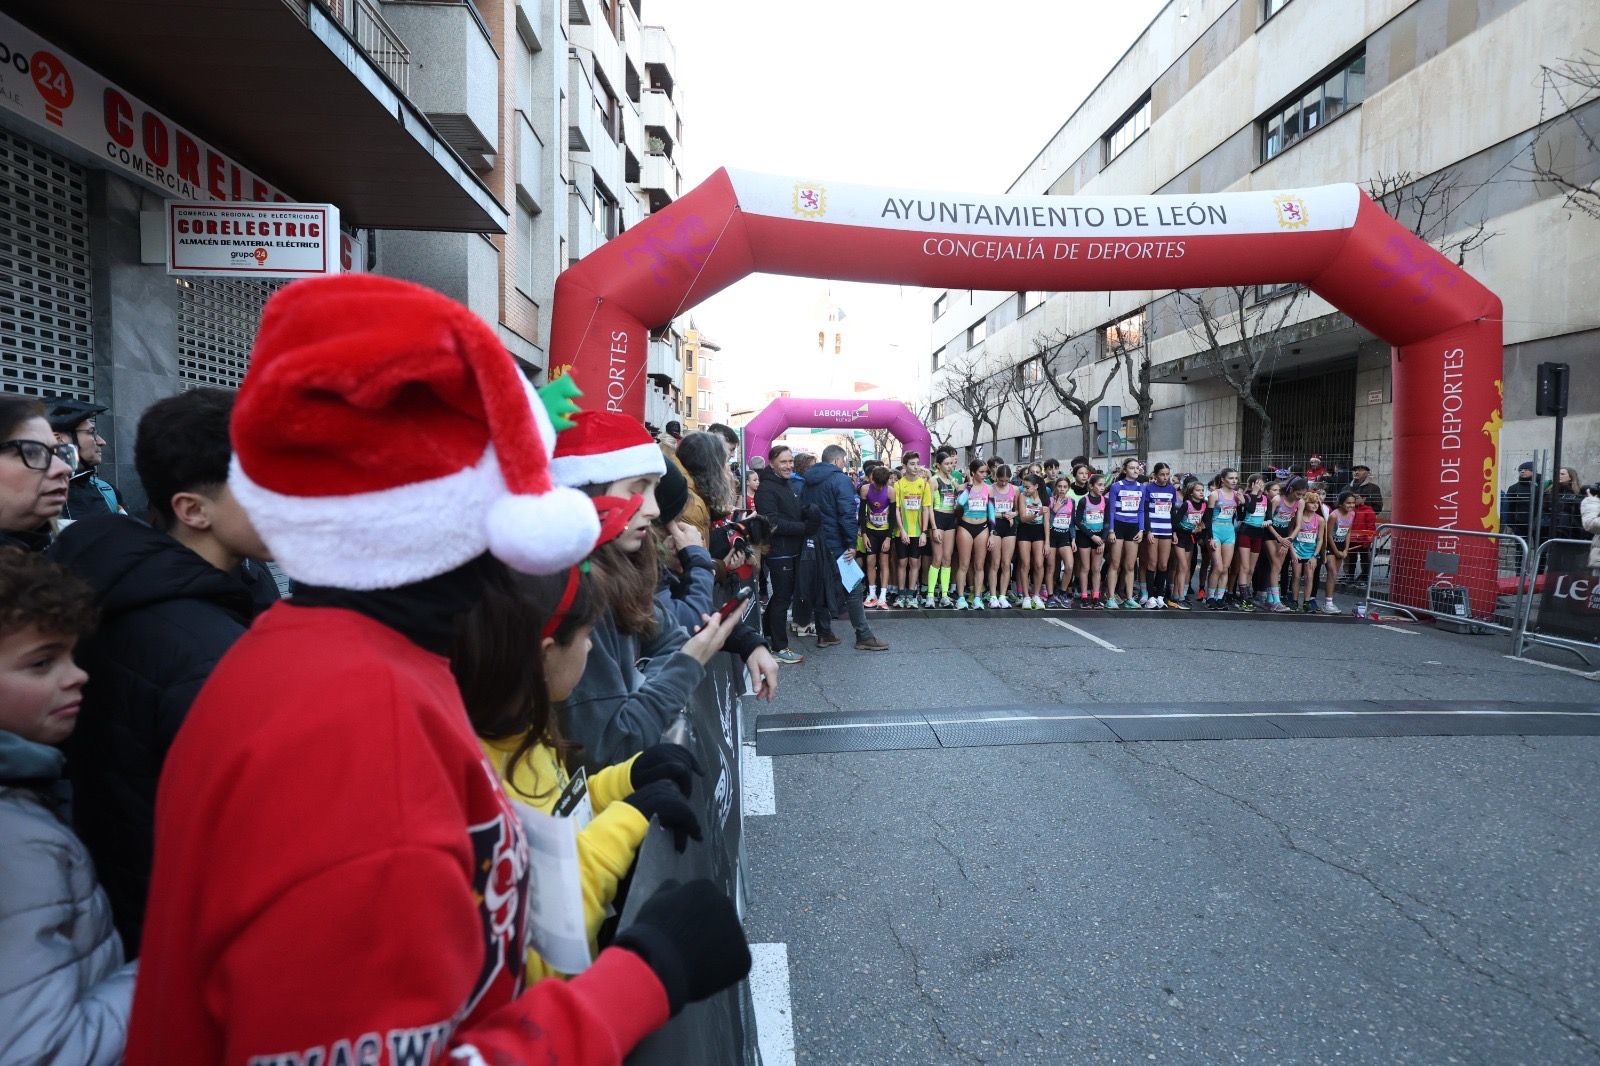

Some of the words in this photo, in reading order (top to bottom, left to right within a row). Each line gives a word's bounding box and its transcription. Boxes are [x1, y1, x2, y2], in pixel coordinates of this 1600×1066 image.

[38, 61, 67, 98] 24
[106, 141, 199, 201] COMERCIAL
[881, 198, 1105, 227] AYUNTAMIENTO
[1113, 207, 1149, 227] DE
[1157, 202, 1228, 227] LEÓN
[177, 219, 320, 238] CORELECTRIC
[179, 237, 219, 246] ALMACÉN
[232, 239, 274, 247] MATERIAL
[276, 239, 320, 248] ELÉCTRICO
[230, 251, 254, 259] grupo
[923, 238, 1046, 262] CONCEJALÍA
[1054, 242, 1079, 261] DE
[1087, 241, 1186, 260] DEPORTES
[606, 331, 628, 413] PORTES
[1441, 348, 1464, 450] DEPORTES
[814, 409, 851, 417] LABORAL
[1441, 457, 1460, 483] DE
